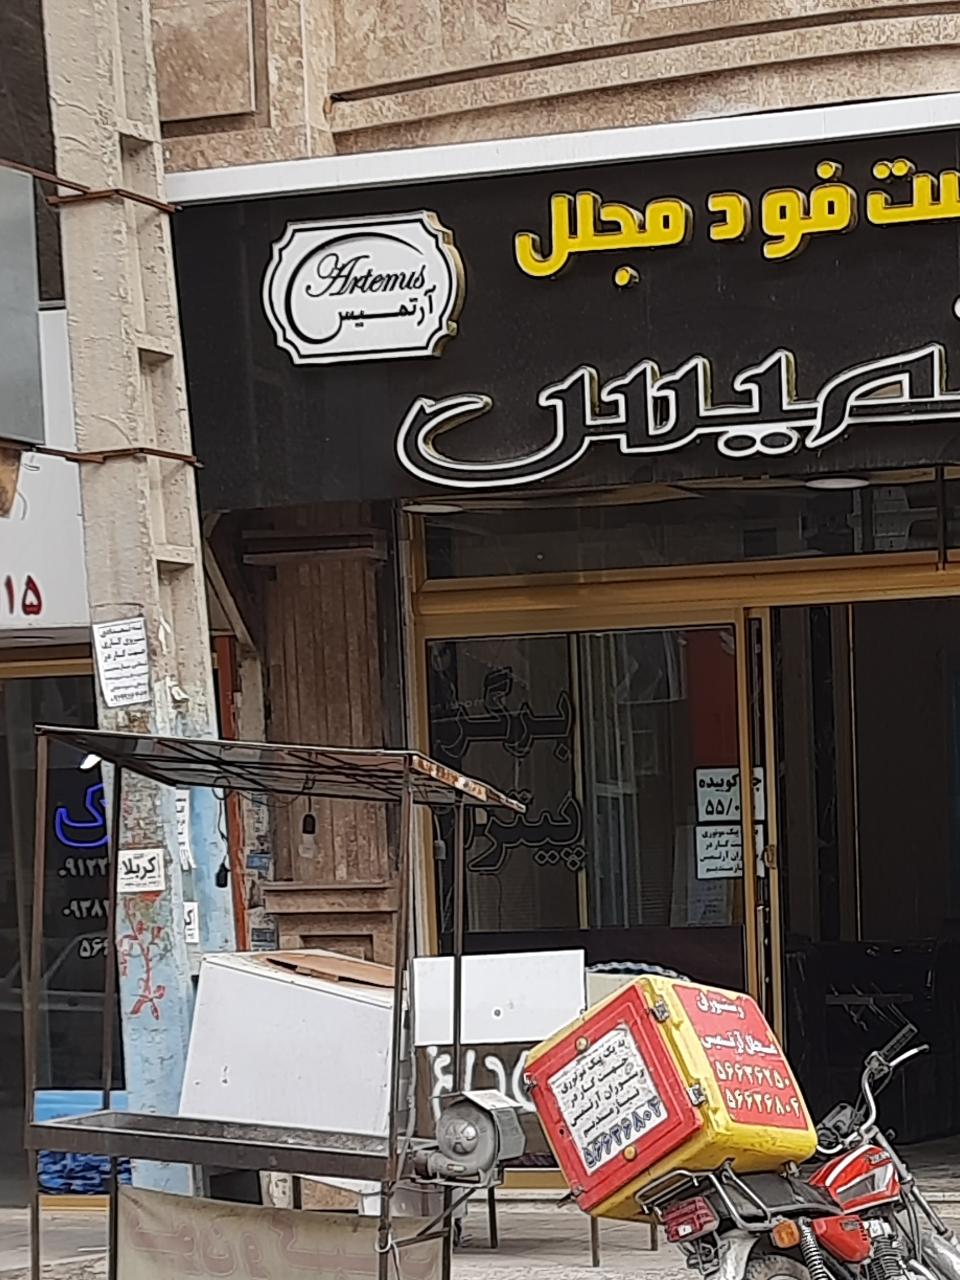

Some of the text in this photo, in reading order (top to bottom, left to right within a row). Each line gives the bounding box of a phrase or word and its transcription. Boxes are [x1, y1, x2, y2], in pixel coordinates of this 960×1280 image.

[514, 191, 694, 289] مجلل
[708, 160, 858, 260] فود
[337, 284, 437, 328] آرتمیس
[122, 856, 157, 880] کربلا
